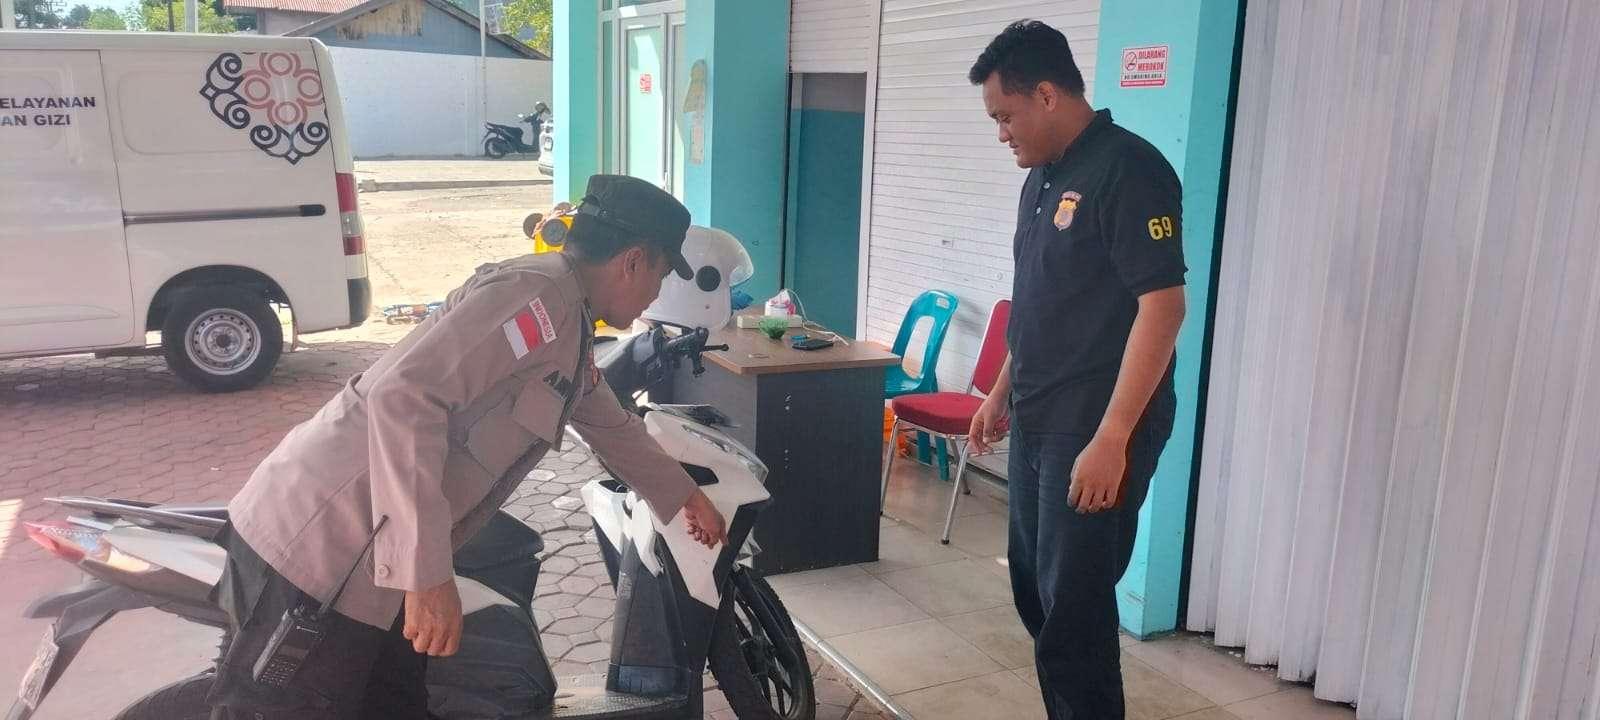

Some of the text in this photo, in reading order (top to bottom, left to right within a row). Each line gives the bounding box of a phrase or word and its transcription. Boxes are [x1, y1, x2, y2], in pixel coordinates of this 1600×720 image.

[1138, 50, 1165, 59] DILARANG
[1137, 62, 1164, 71] MEROKOK
[34, 114, 71, 126] GIZI
[1148, 216, 1172, 240] 69
[532, 300, 554, 339] INDONESIA
